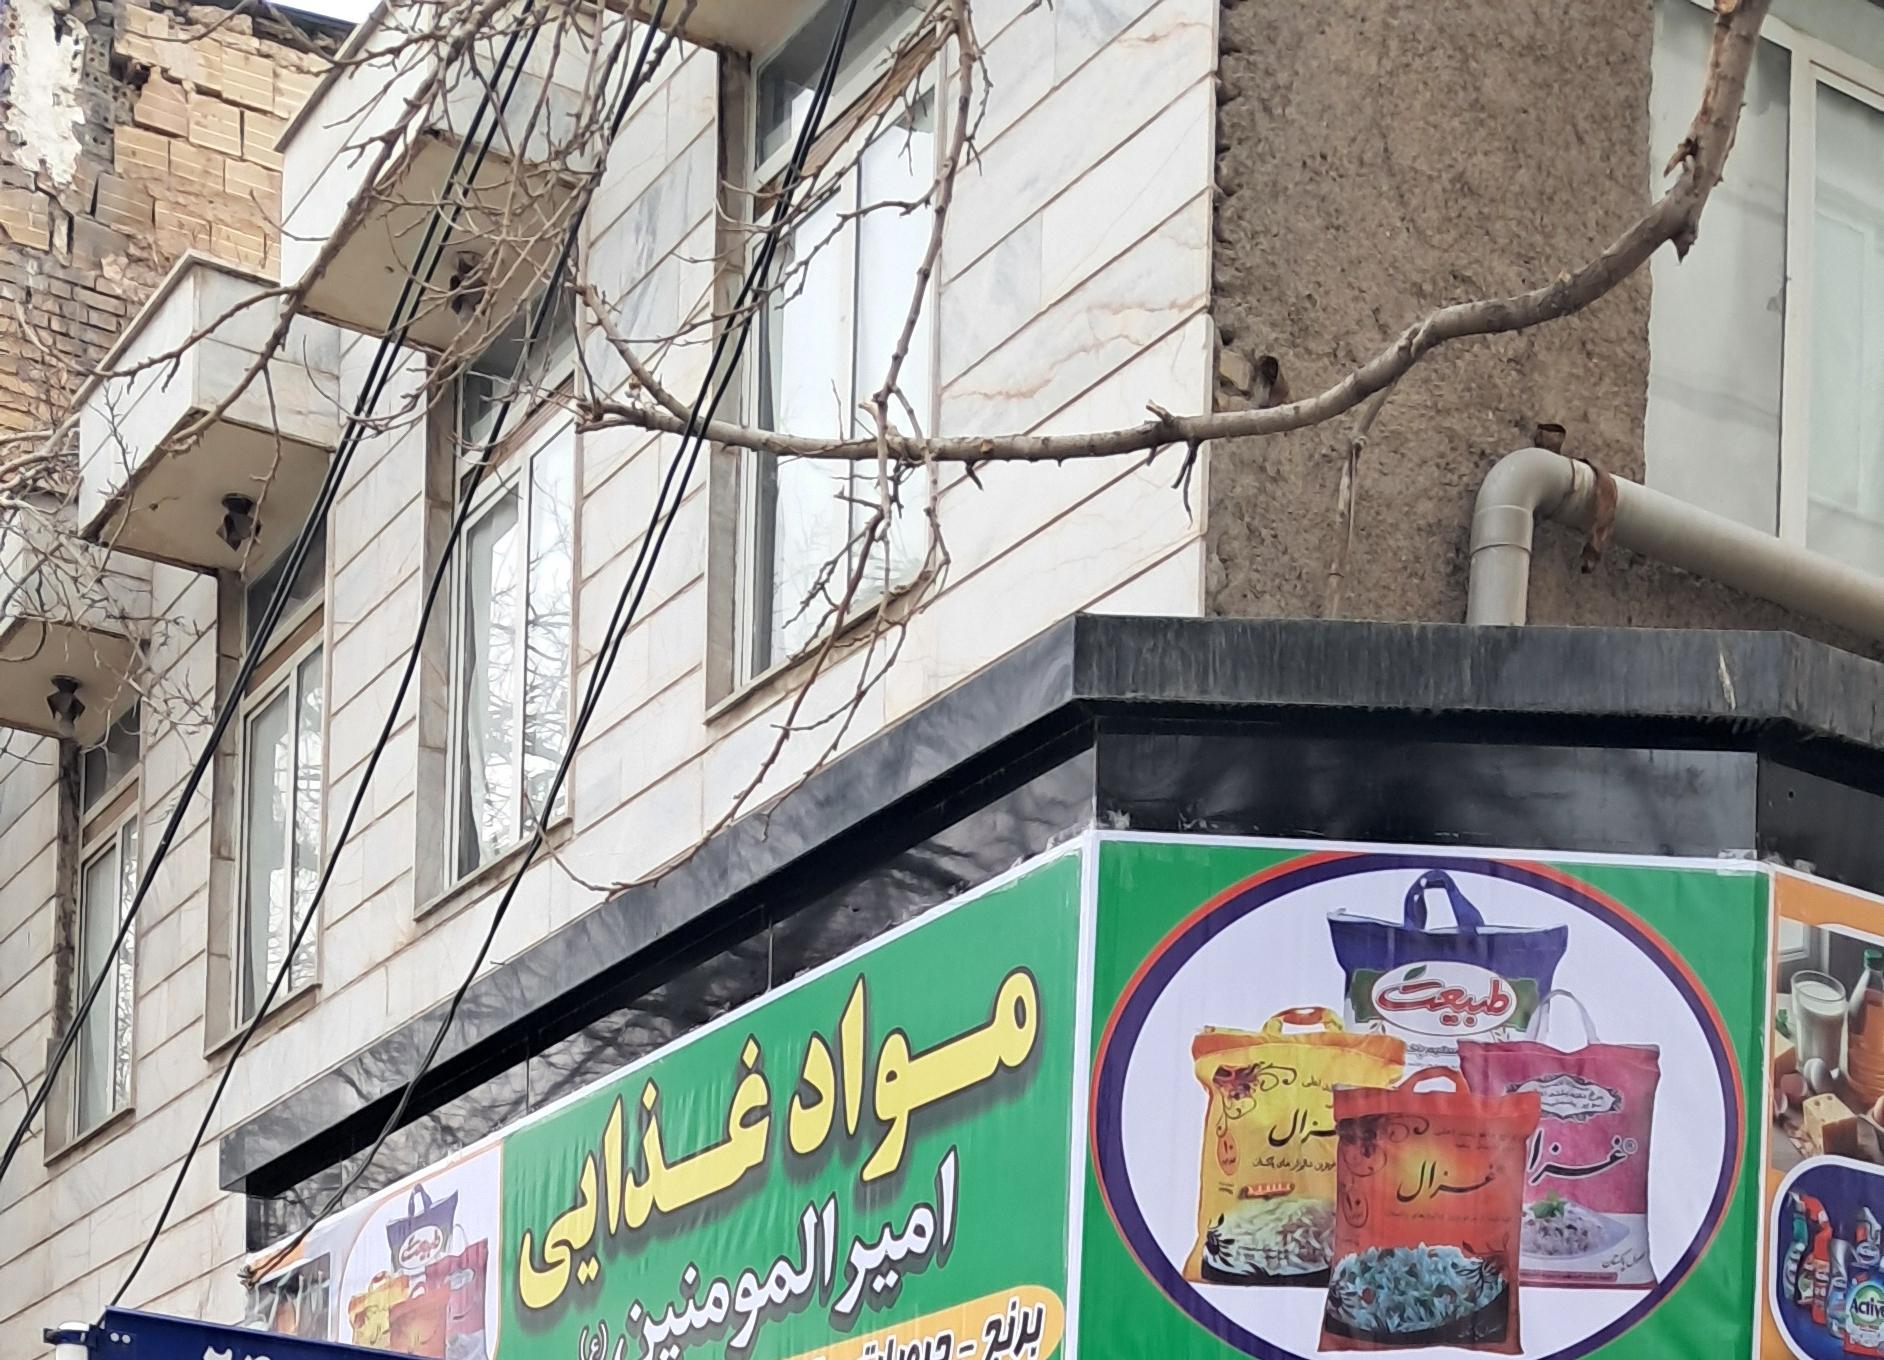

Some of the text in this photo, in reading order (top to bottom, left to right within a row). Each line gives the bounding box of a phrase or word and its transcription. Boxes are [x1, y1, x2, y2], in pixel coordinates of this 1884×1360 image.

[1376, 977, 1511, 1026] طبیعت
[519, 966, 1039, 1309] مواد غذایی
[1268, 1108, 1336, 1147] زال
[1396, 1159, 1498, 1203] غزال
[1527, 1129, 1626, 1184] غزا
